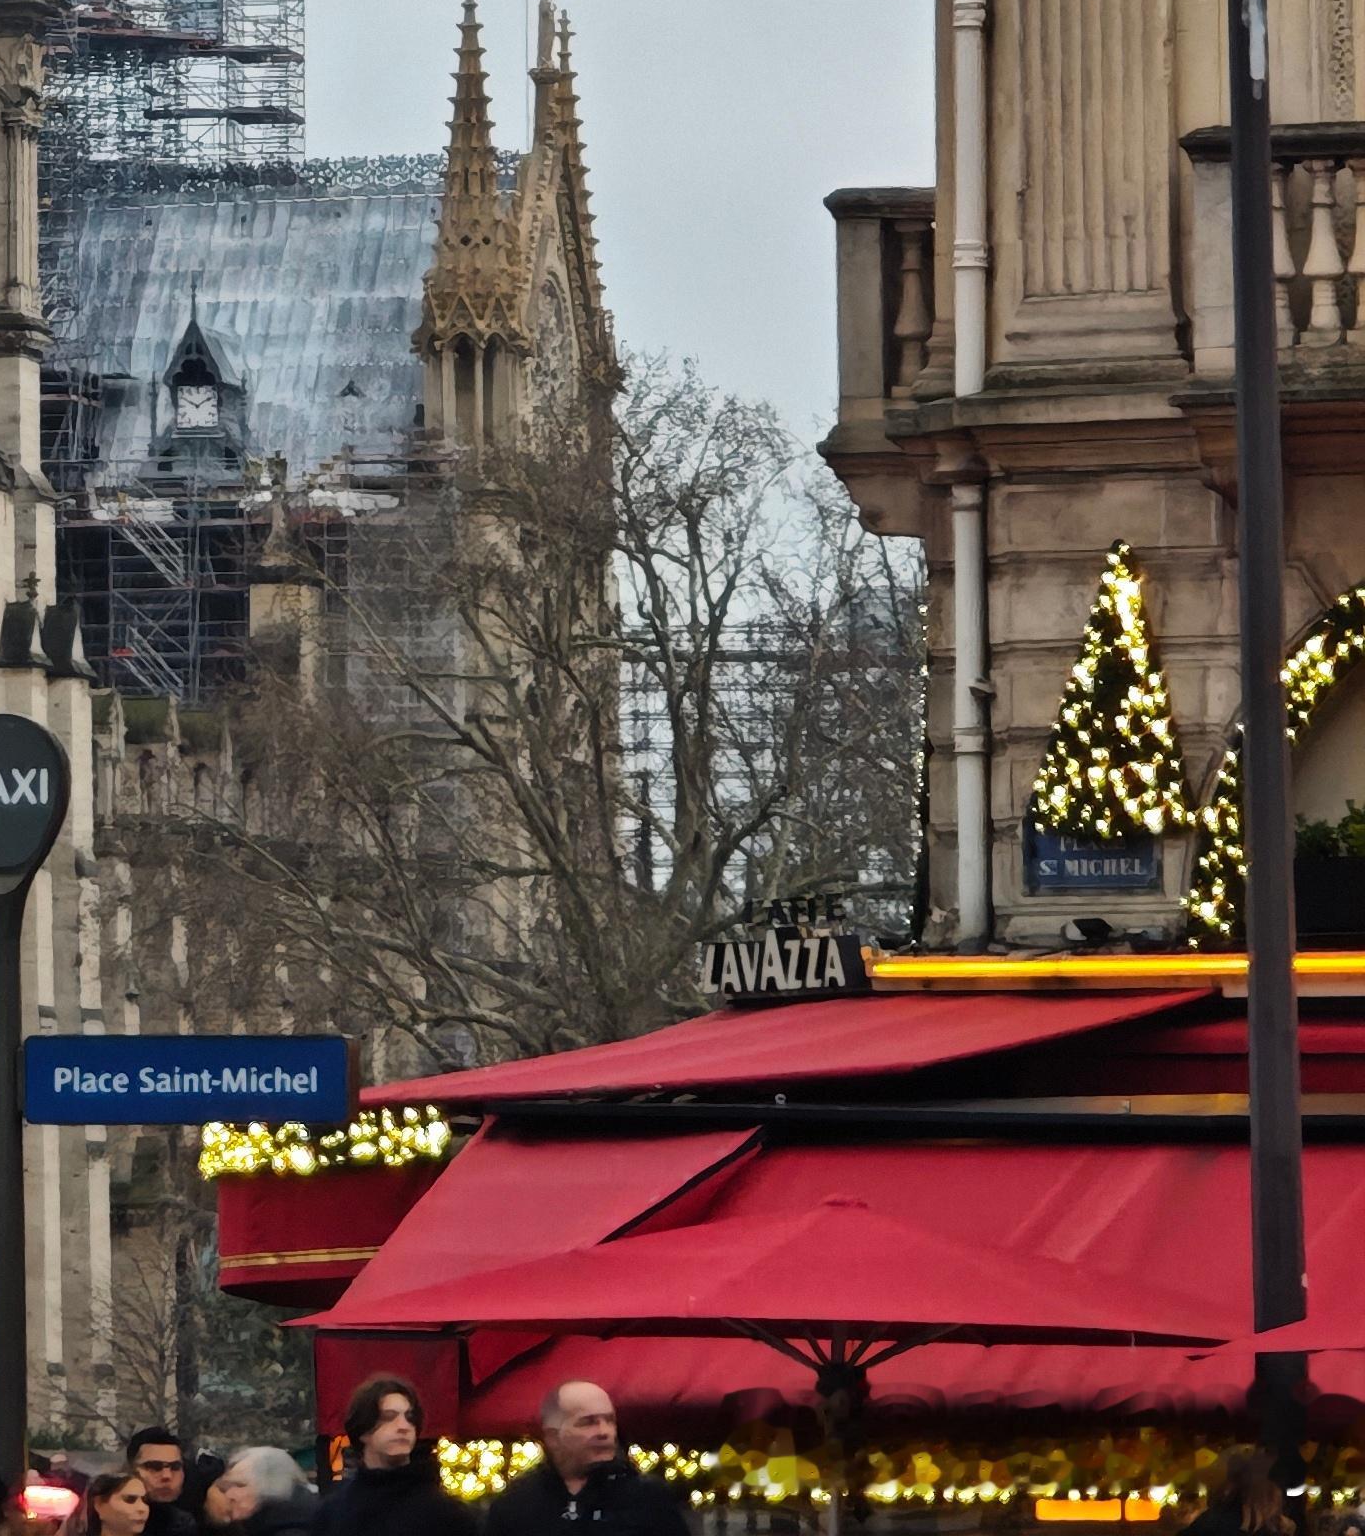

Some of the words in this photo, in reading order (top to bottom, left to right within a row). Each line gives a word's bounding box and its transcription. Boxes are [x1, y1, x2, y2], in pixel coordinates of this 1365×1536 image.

[1064, 857, 1149, 876] MICHEL
[702, 929, 846, 994] LAVAZZA
[53, 1066, 129, 1094] Place
[139, 1065, 318, 1094] Saint-Michel
